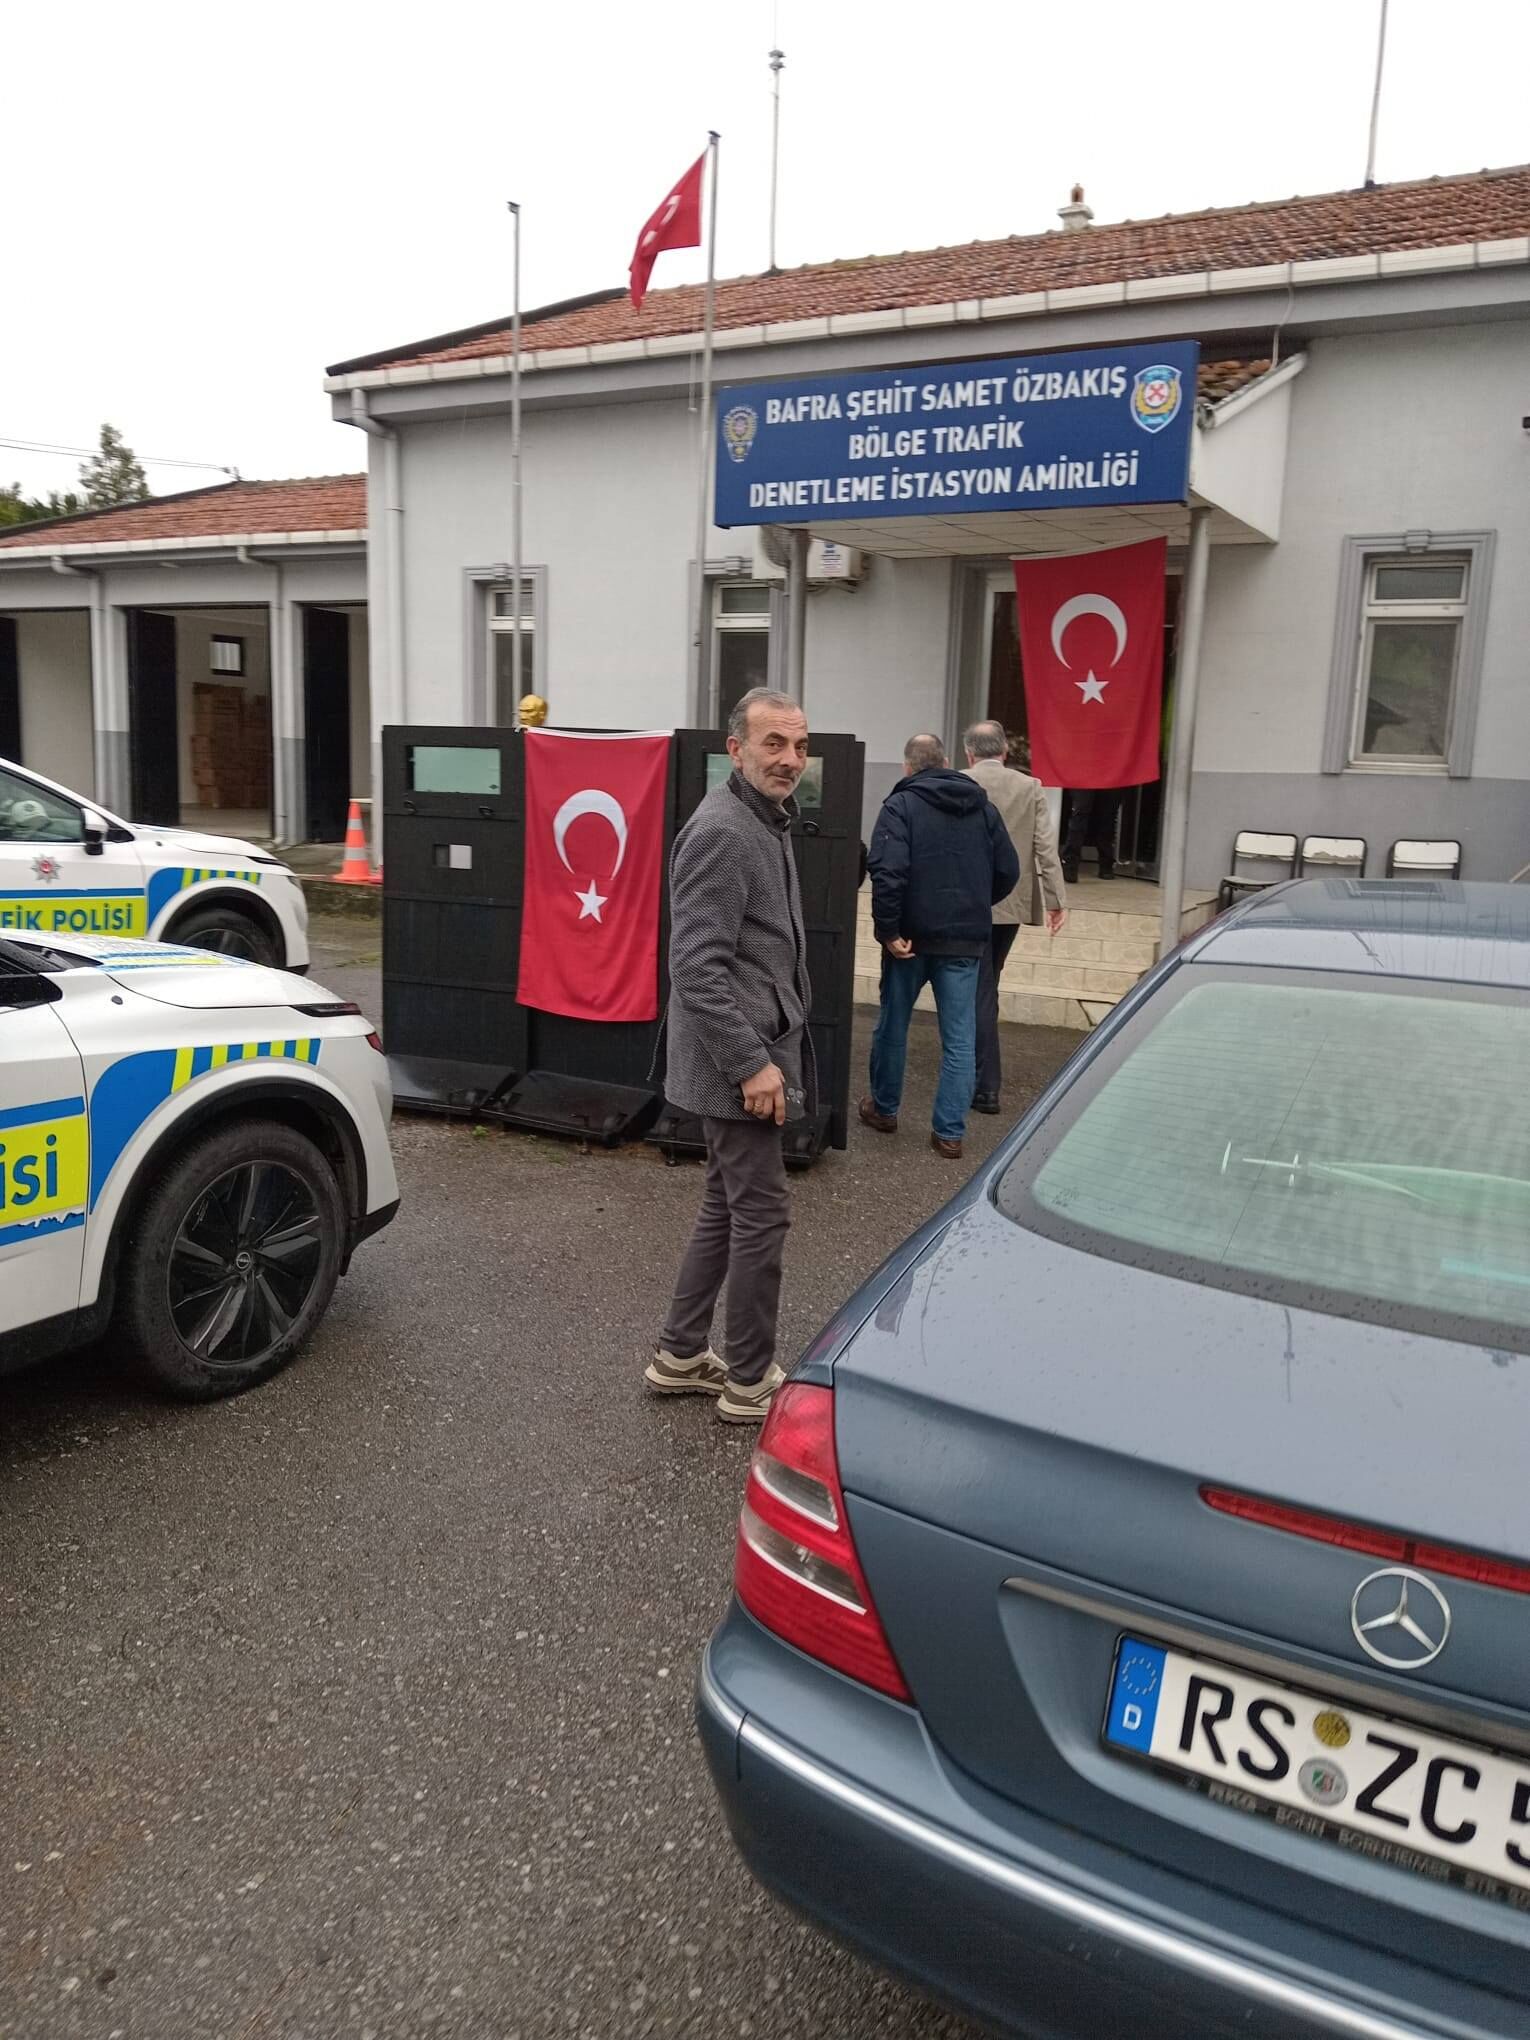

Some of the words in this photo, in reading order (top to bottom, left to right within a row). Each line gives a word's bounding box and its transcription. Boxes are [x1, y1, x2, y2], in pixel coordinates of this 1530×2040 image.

[766, 394, 842, 424] BAFRA
[847, 380, 918, 420] ŞEHİT
[921, 376, 1008, 411] SAMET
[1013, 365, 1127, 403] ÖZBAKIŞ
[849, 425, 927, 460] BÖLGE
[932, 414, 1024, 453] TRAFİK
[749, 474, 886, 508] DENETLEME
[891, 466, 1012, 500] İSTASYON
[1016, 449, 1139, 493] AMİRLİĞİ
[1, 905, 42, 930] FİK
[53, 903, 133, 931] POLİSİ
[1121, 1702, 1142, 1731] D
[1178, 1674, 1296, 1781] RS
[1354, 1732, 1481, 1845] ZC
